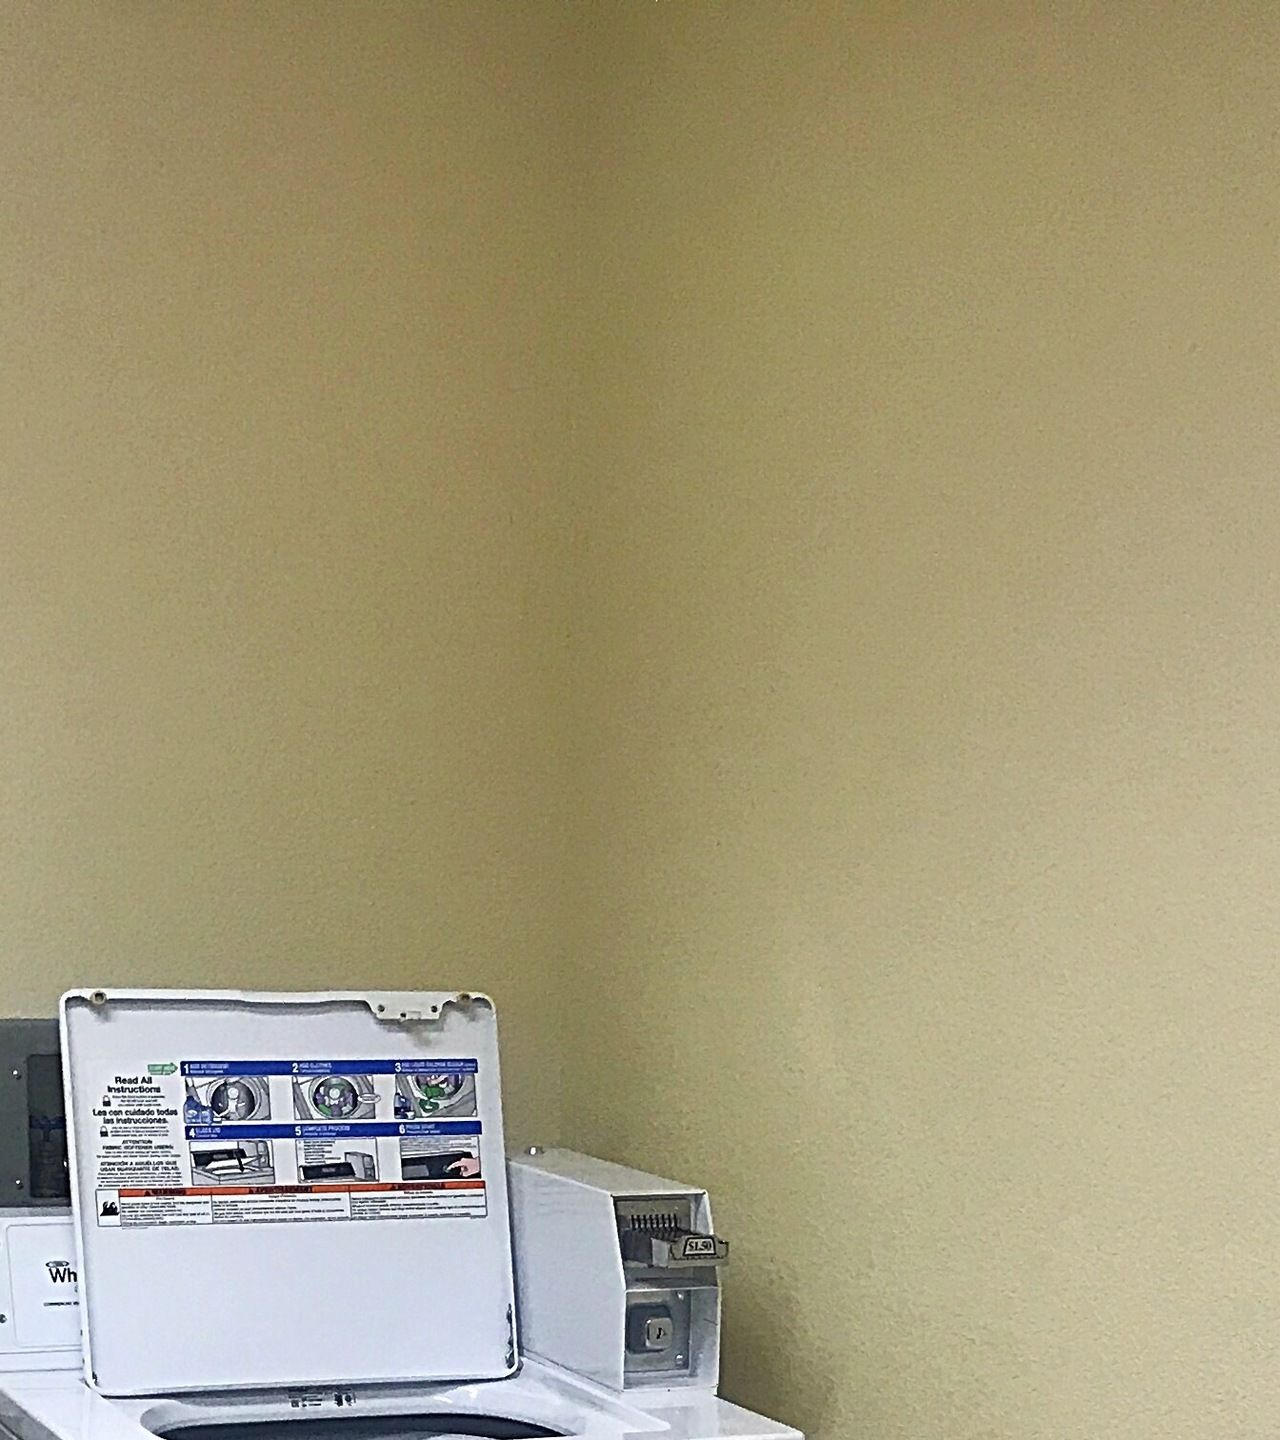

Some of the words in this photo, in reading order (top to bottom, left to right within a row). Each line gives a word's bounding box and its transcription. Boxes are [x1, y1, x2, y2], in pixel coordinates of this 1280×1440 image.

[114, 1076, 139, 1085] Read
[140, 1076, 153, 1085] All
[107, 1085, 161, 1093] Instructions
